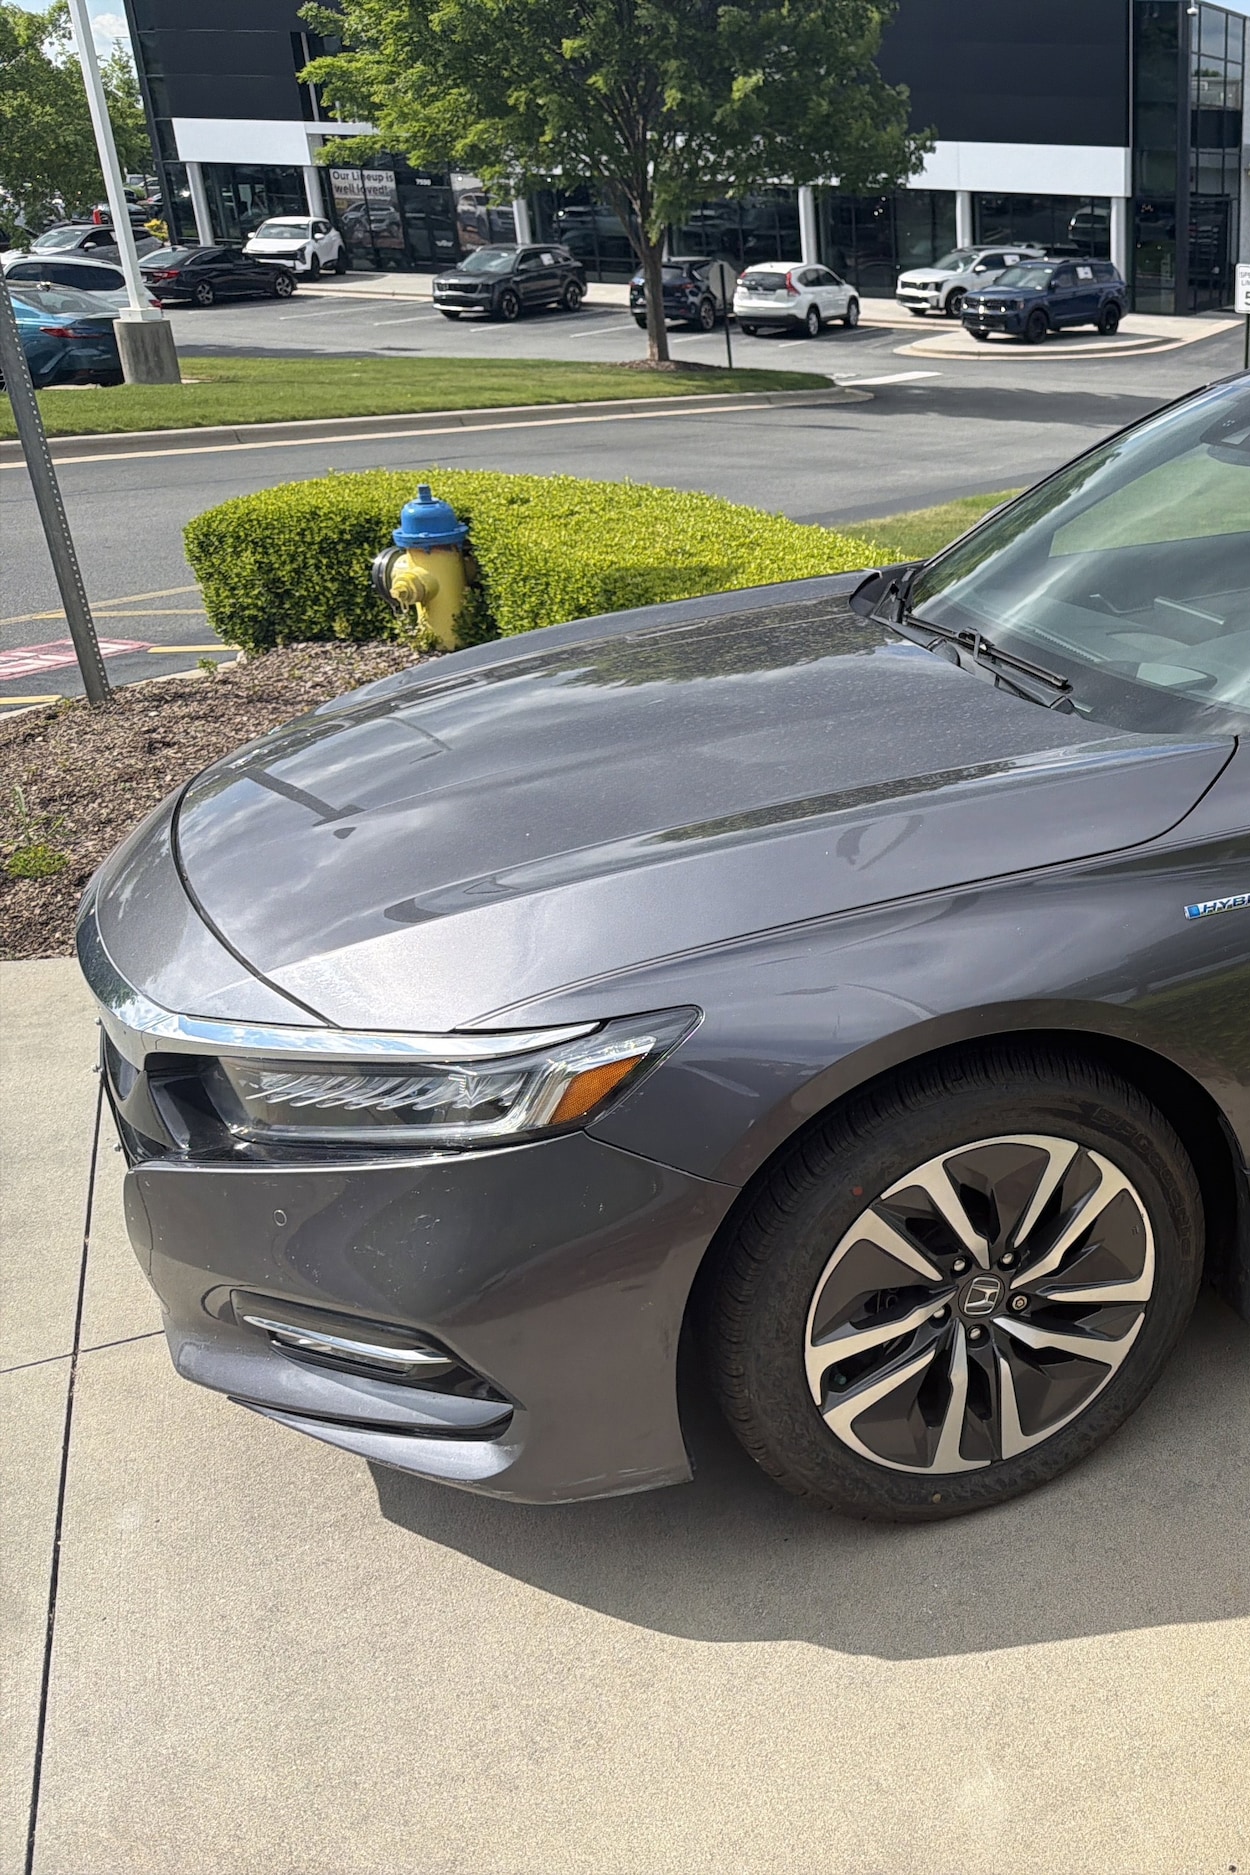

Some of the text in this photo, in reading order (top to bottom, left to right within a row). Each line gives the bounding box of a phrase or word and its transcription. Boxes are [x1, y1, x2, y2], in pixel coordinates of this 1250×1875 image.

[332, 170, 349, 181] Our
[386, 172, 394, 183] is
[334, 183, 354, 194] well
